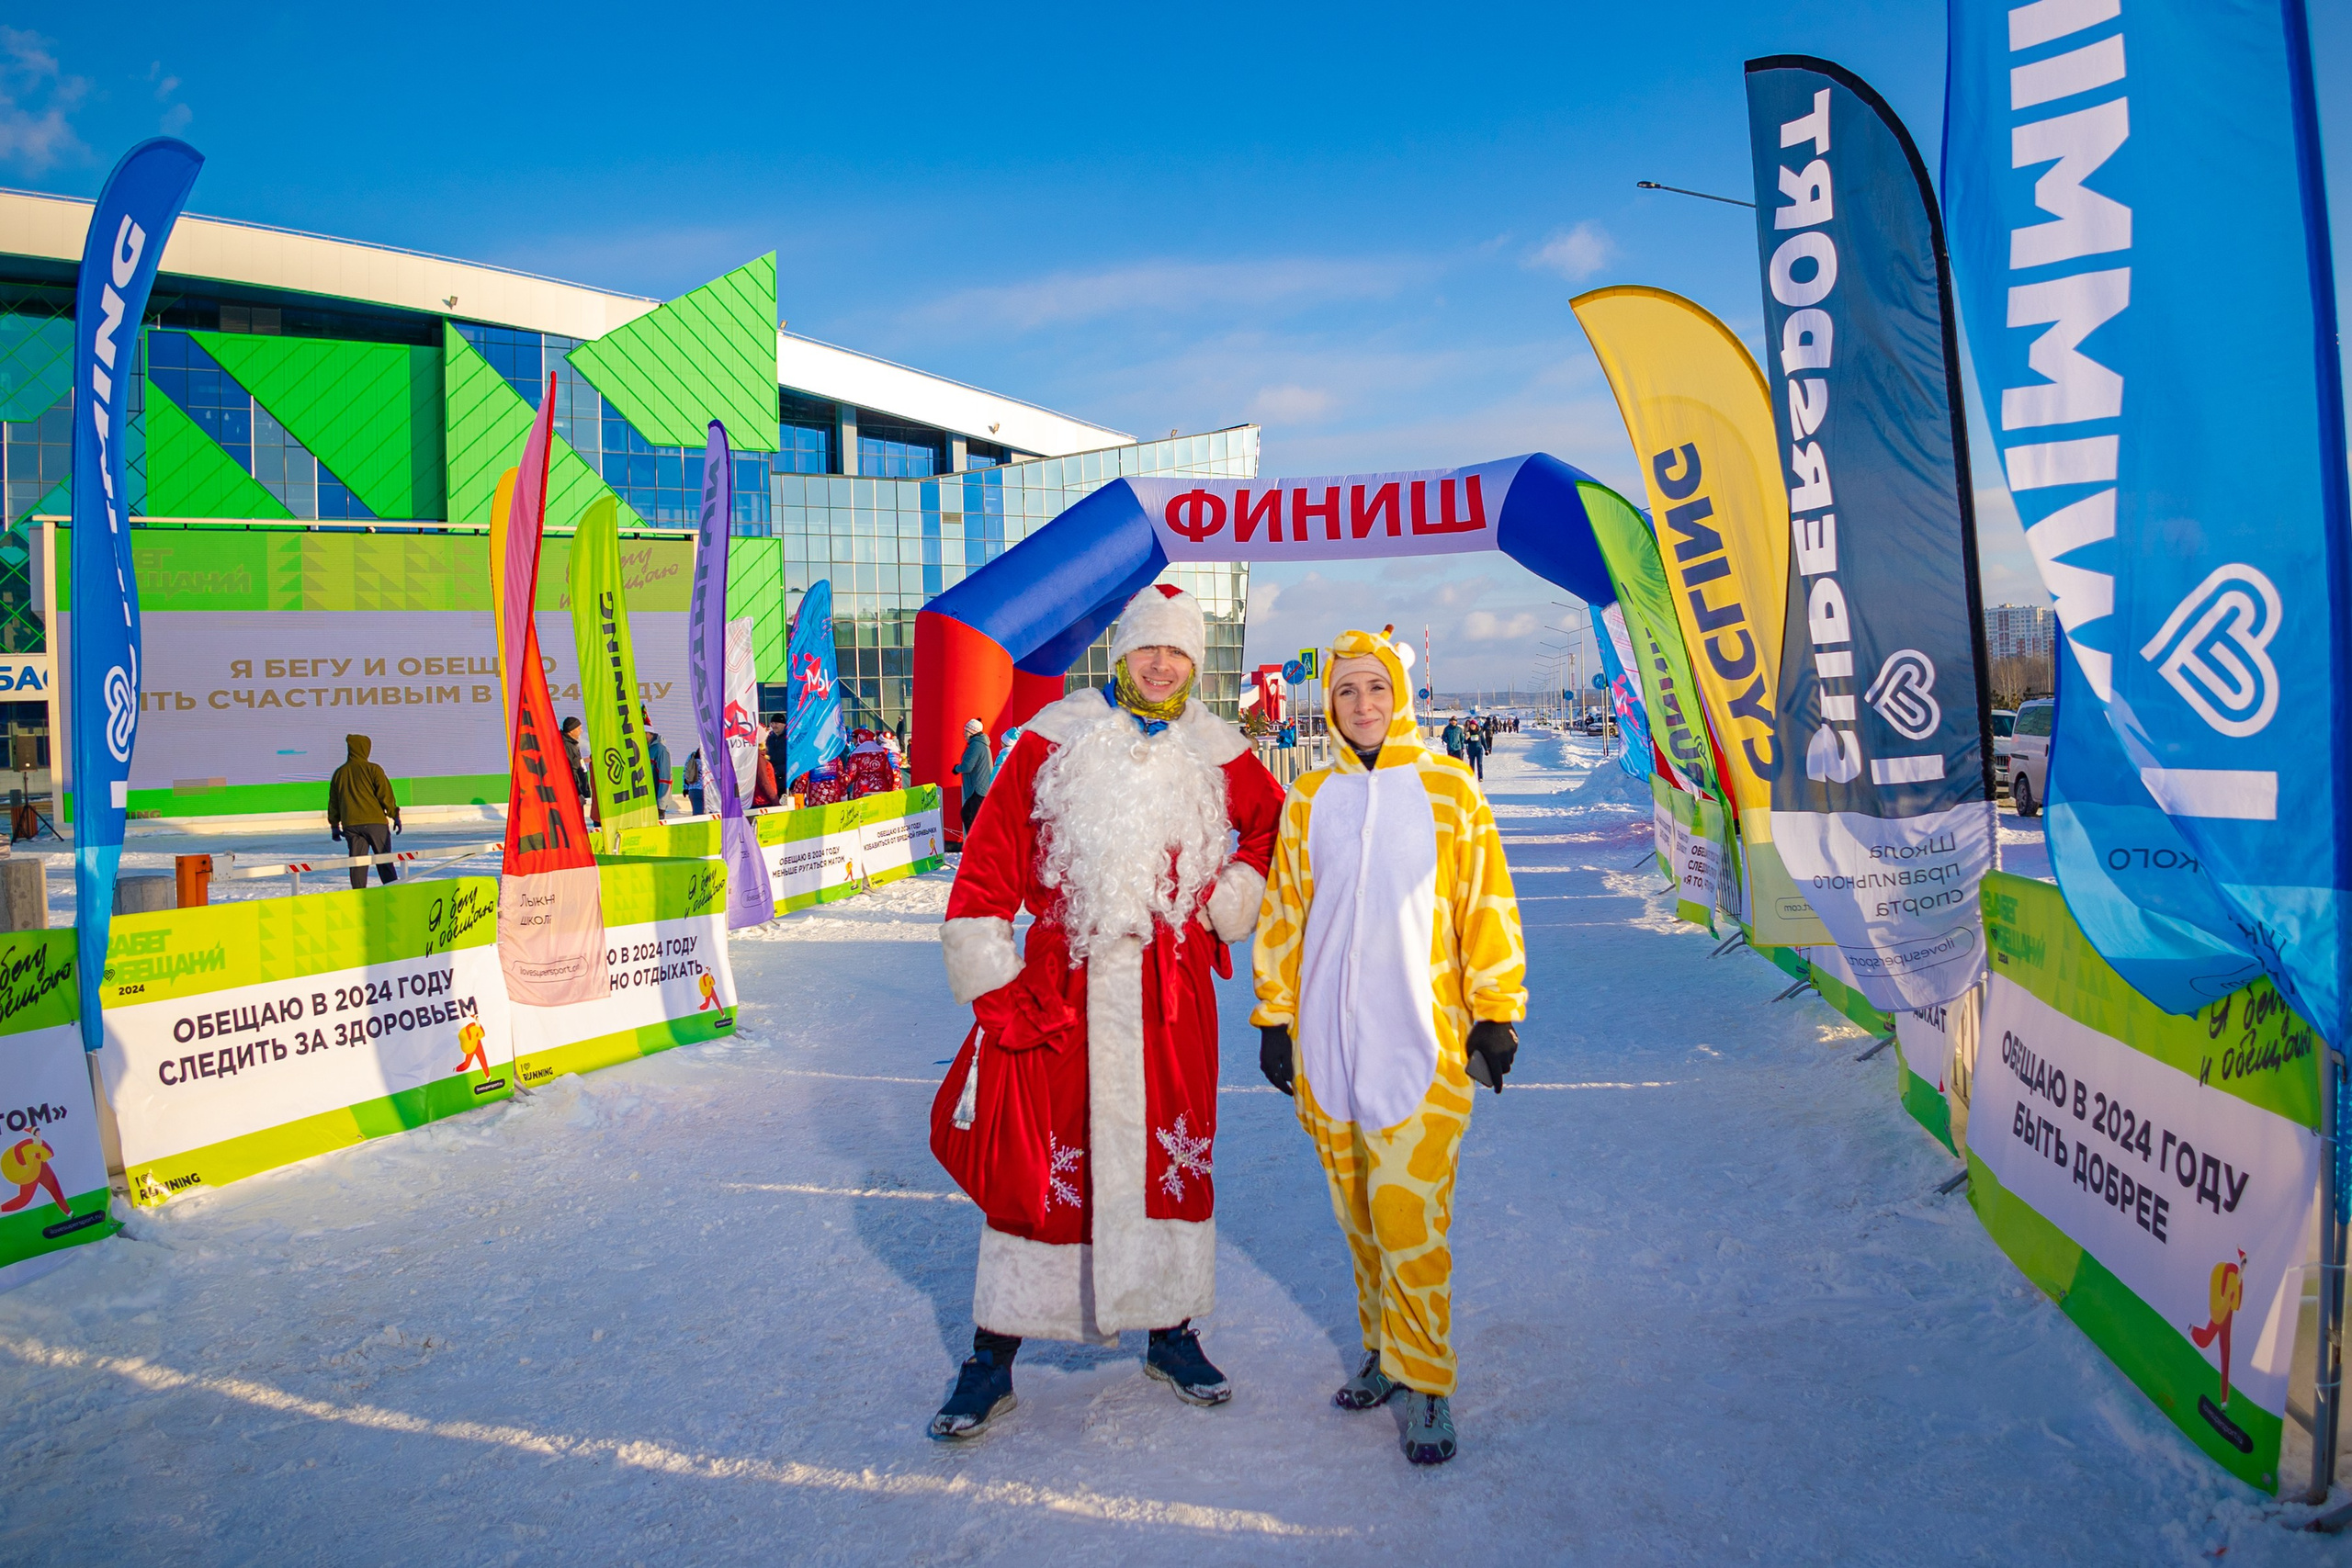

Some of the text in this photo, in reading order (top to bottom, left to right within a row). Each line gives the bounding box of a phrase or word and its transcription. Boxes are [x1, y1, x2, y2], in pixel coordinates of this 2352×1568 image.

[1165, 474, 1487, 543] ФИНИШ
[0, 666, 48, 691] БА
[231, 660, 253, 678] Я
[266, 658, 353, 678] БЕГУ
[365, 658, 386, 676] И
[140, 682, 673, 712] ТЬ СЧАСТЛИВЫМ В 24 ДУ
[600, 591, 649, 799] RUNNING
[772, 866, 797, 878] МЕНЬШЕ
[798, 860, 827, 874] РУГАТЬСЯ
[779, 853, 807, 866] ОБЕЩАЮ
[812, 850, 824, 859] 2024
[825, 846, 840, 856] ГОДУ
[429, 886, 478, 931] Я бегу
[426, 901, 493, 958] и обещаю
[621, 947, 629, 964] В
[633, 942, 663, 962] 2024
[666, 936, 697, 957] ГОДУ
[633, 959, 703, 987] ОТДЫХАТЬ
[119, 984, 145, 996] 2024
[173, 968, 455, 1043] ОБЕЩАЮ В 2024 ГОДУ
[159, 996, 479, 1086] СЛЕДИТЬ ЗА ЗДОРОВЬЕМ
[523, 1066, 554, 1082] RUNNING
[2002, 1030, 2250, 1215] ОБЕЩАЮ В 2024 ГОДУ
[2012, 1100, 2170, 1245] БЫТЬ ДОБРЕЕ
